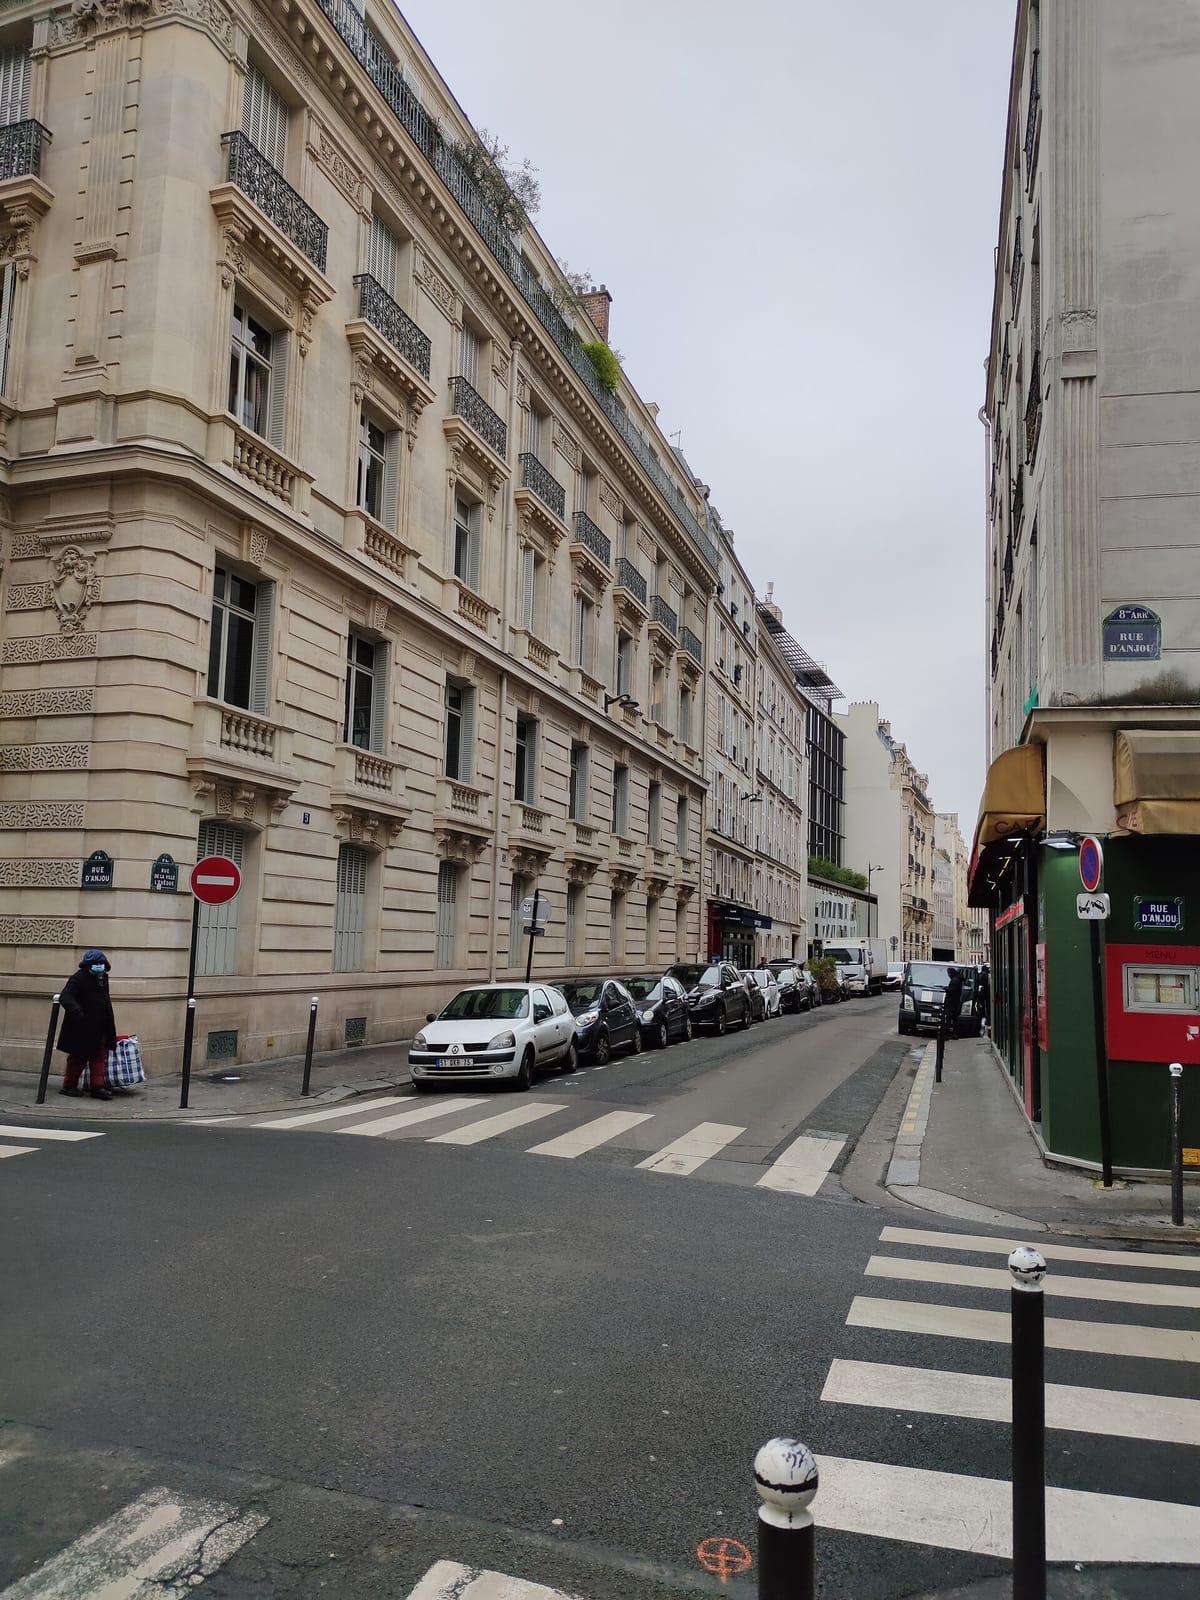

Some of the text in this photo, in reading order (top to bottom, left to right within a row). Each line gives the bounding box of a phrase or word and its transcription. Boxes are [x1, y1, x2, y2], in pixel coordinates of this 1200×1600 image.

[1120, 633, 1144, 641] RUE
[1109, 644, 1153, 653] D'ANJOU
[1150, 904, 1169, 913] RUE
[1141, 913, 1177, 923] D'ANJOU
[1144, 949, 1176, 959] MENU
